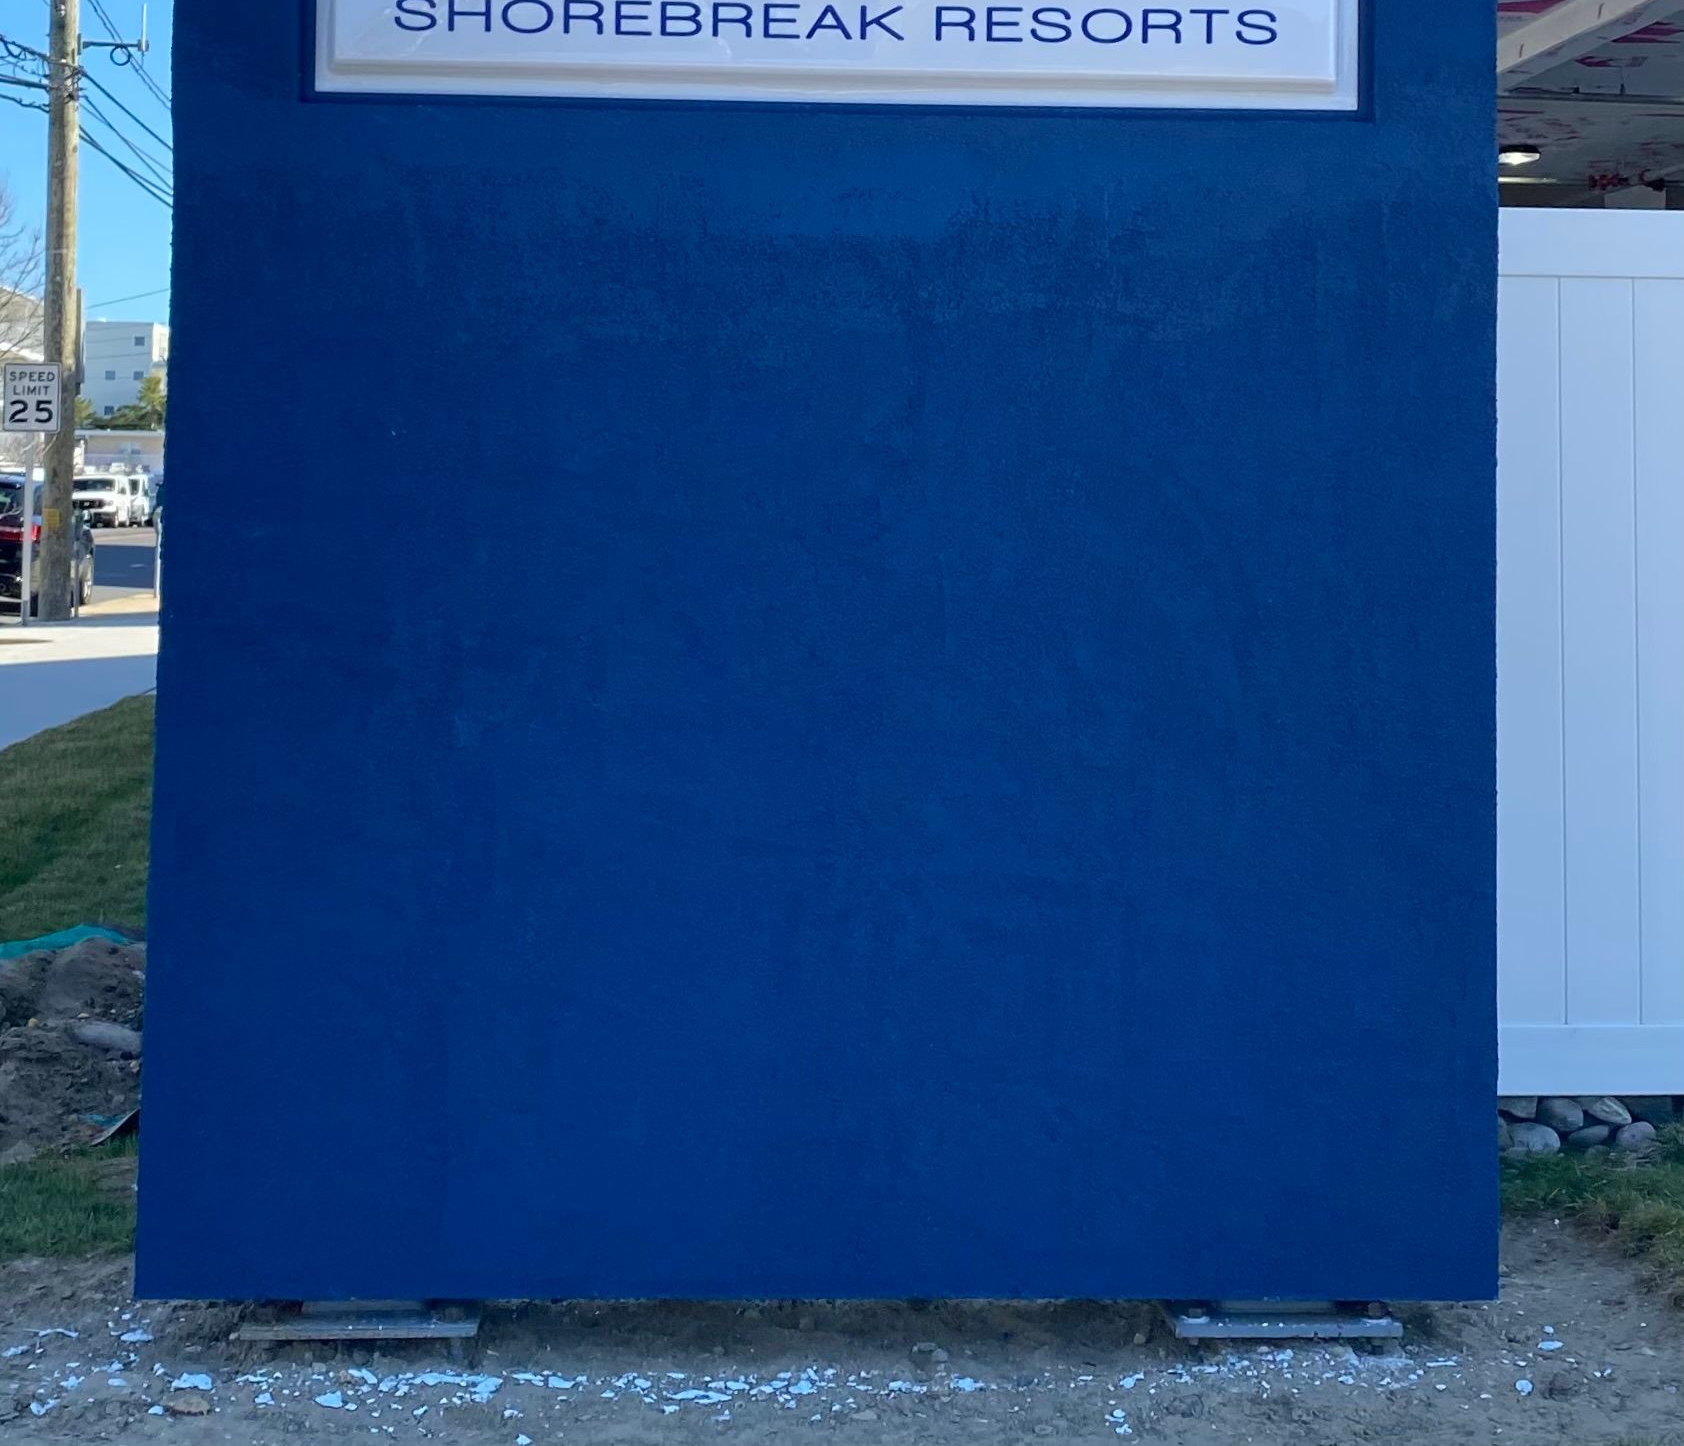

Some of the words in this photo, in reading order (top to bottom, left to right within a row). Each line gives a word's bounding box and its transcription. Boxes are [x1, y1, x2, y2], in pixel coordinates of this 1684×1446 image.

[935, 5, 1278, 46] RESORTS
[9, 371, 56, 382] SPEED
[13, 385, 50, 396] LIMIT
[9, 399, 54, 423] 25
